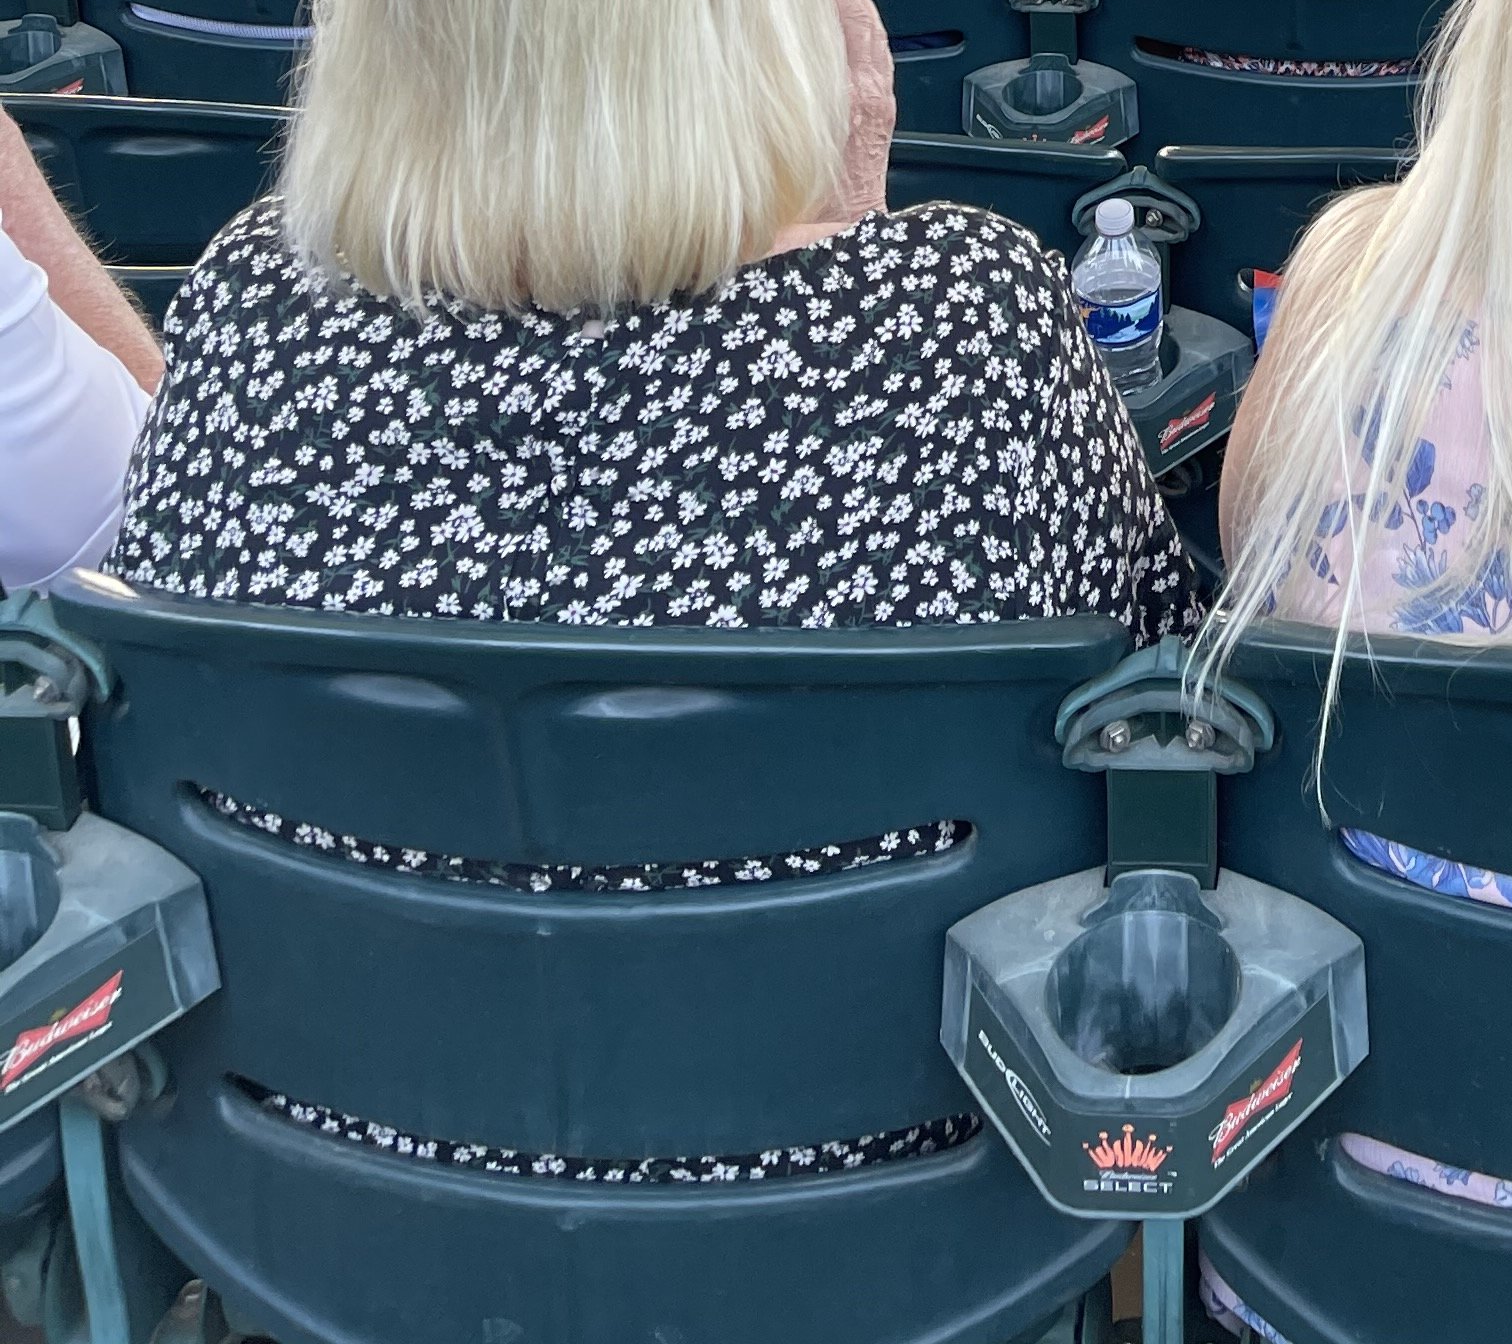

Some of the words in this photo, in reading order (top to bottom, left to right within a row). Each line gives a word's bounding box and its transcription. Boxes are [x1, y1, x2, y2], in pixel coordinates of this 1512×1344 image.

[978, 1029, 1006, 1073] BUD
[1010, 1077, 1052, 1135] LIGHT
[1208, 1056, 1301, 1149] Budweiser
[1083, 1179, 1173, 1194] SELECT
